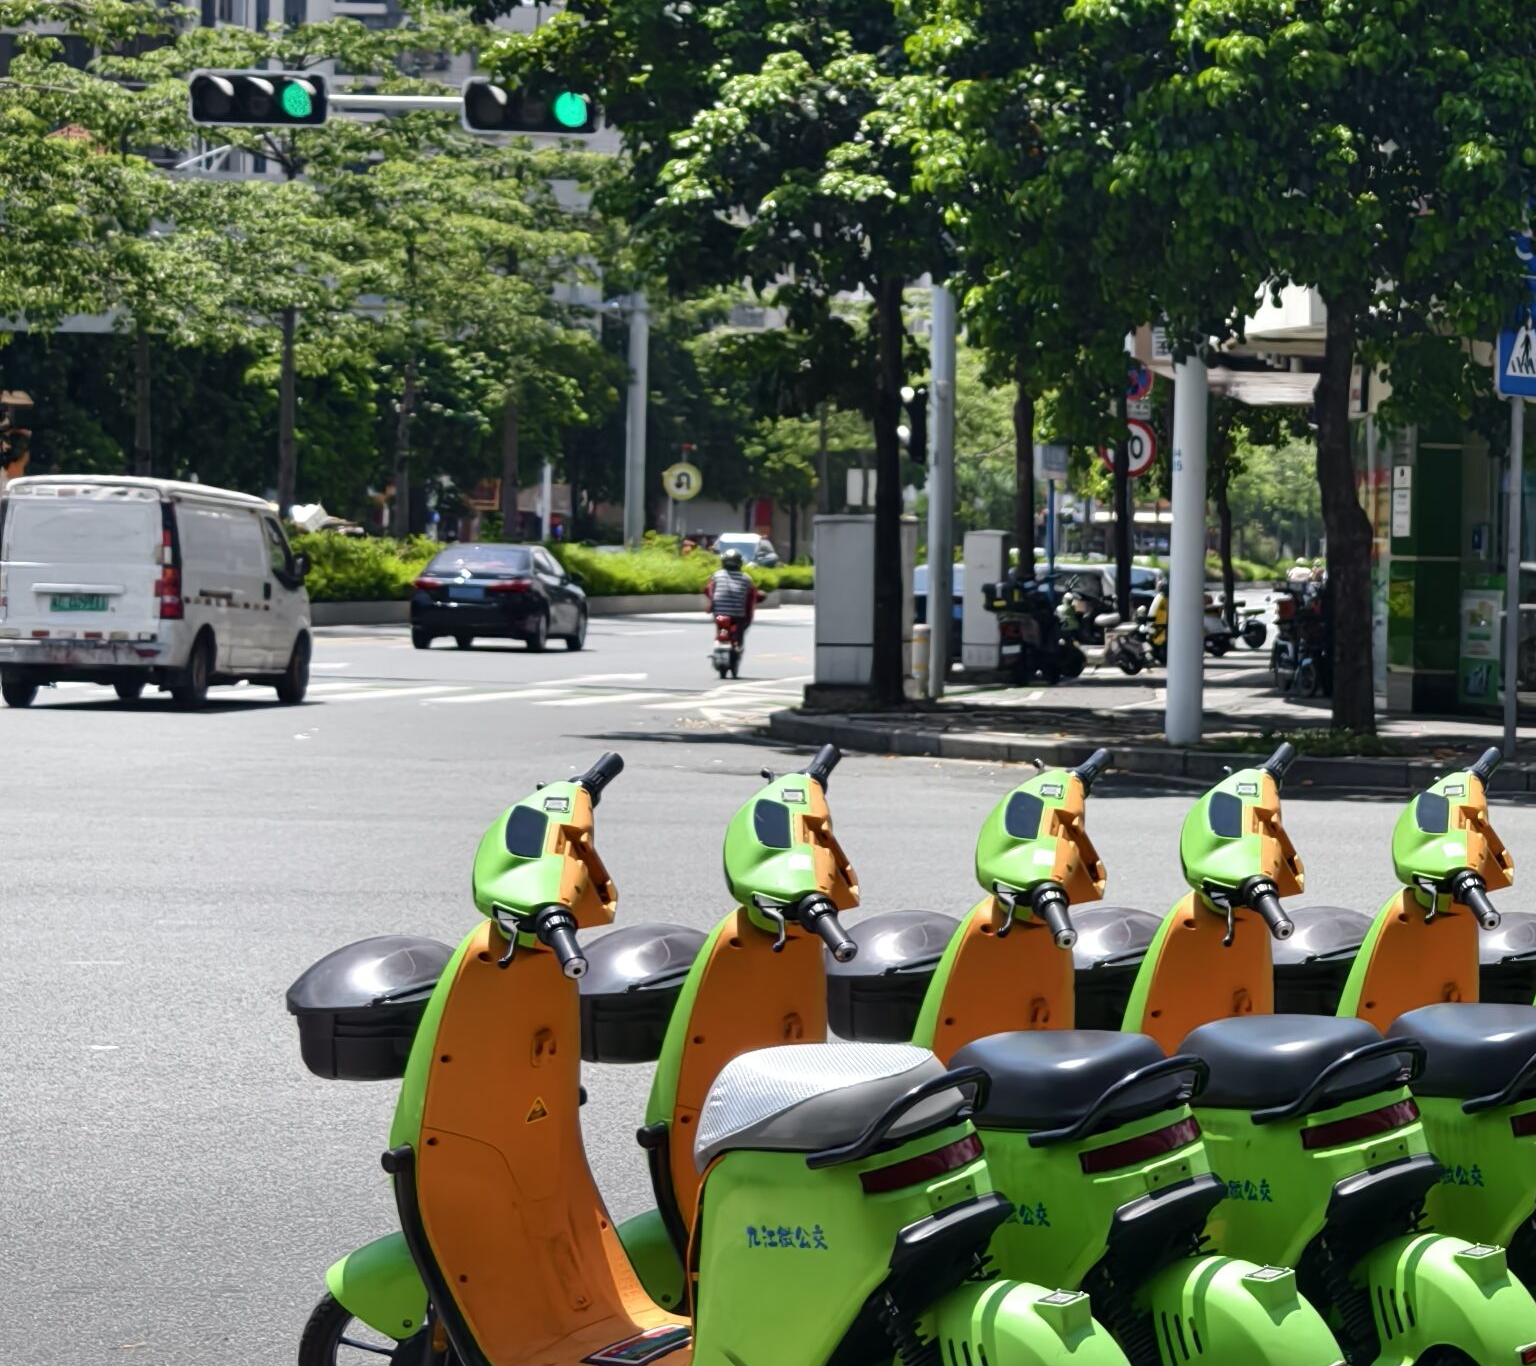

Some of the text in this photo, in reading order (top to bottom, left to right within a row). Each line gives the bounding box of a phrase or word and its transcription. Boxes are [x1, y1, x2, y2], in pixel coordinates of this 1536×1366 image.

[746, 1224, 828, 1250] 九江微公交
